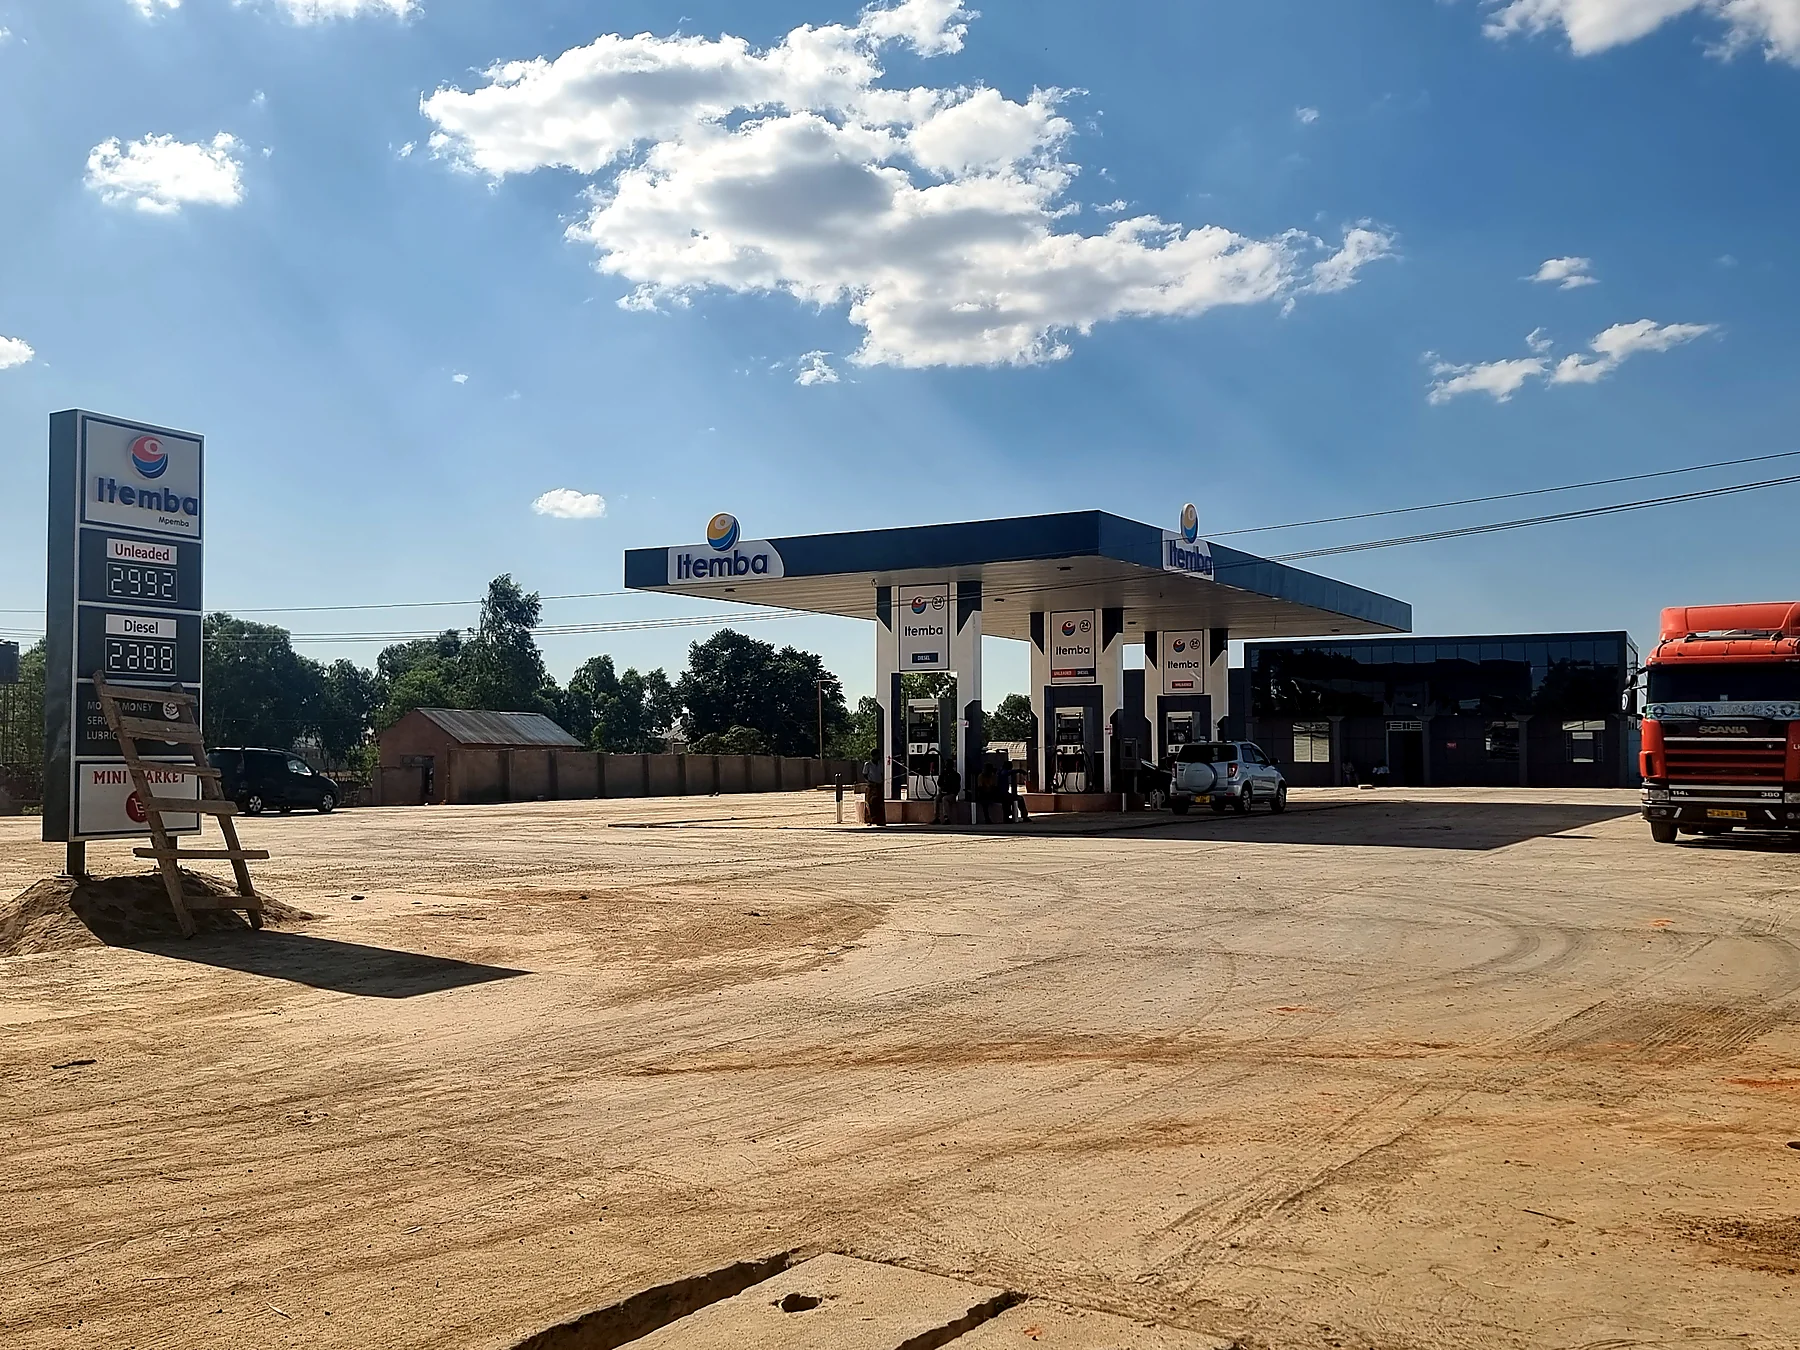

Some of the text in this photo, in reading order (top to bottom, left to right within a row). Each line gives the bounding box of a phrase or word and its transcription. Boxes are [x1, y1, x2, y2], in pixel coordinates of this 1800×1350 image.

[96, 476, 198, 517] Itemba
[158, 516, 190, 528] Mpemba
[115, 543, 170, 561] Unleaded
[1168, 540, 1212, 575] Itemba
[677, 550, 768, 580] Itemba
[111, 567, 174, 598] 2992
[124, 619, 159, 635] Diesel
[904, 625, 943, 637] Itemba
[1055, 645, 1090, 656] Itemba
[1167, 660, 1199, 669] Itemba
[121, 702, 153, 712] MONEY
[86, 730, 118, 740] LUBRIC
[1698, 725, 1749, 734] SCANIA
[93, 769, 185, 785] MINI ARKE
